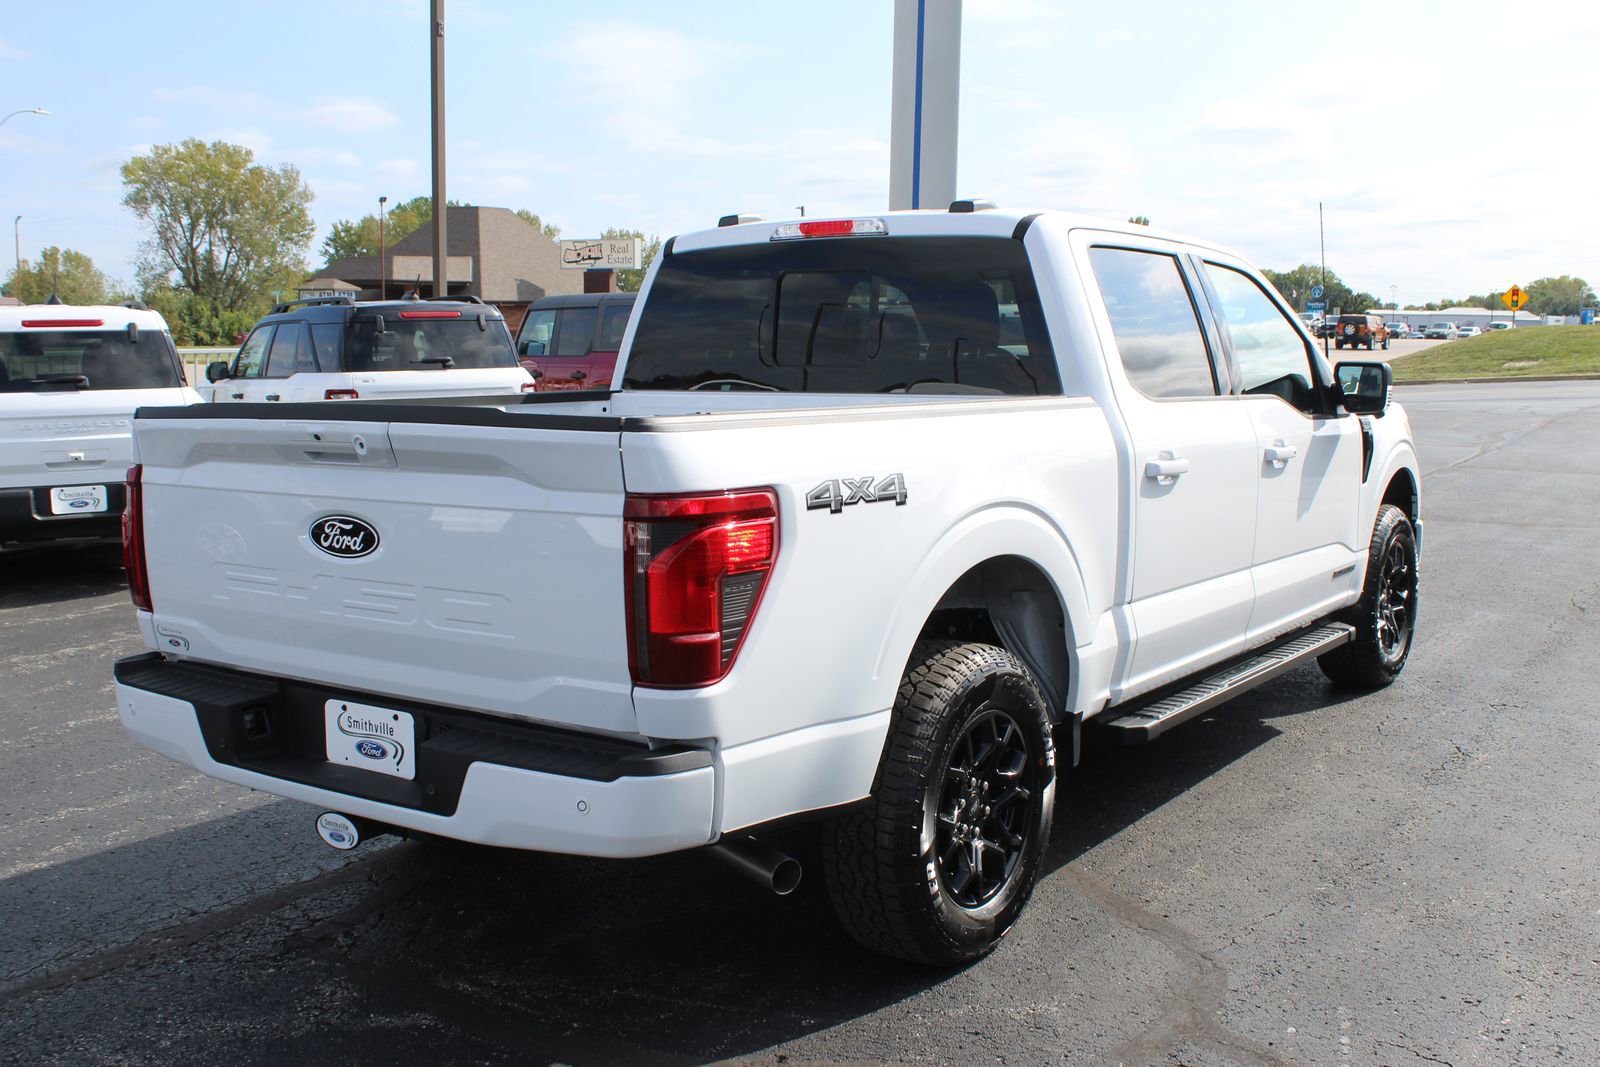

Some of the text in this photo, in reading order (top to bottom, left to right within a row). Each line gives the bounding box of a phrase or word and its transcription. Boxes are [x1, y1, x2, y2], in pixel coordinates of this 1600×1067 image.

[610, 243, 629, 254] Real
[607, 254, 633, 265] Estate
[320, 521, 364, 551] Ford
[347, 715, 394, 736] Smithville
[360, 742, 383, 757] Ford
